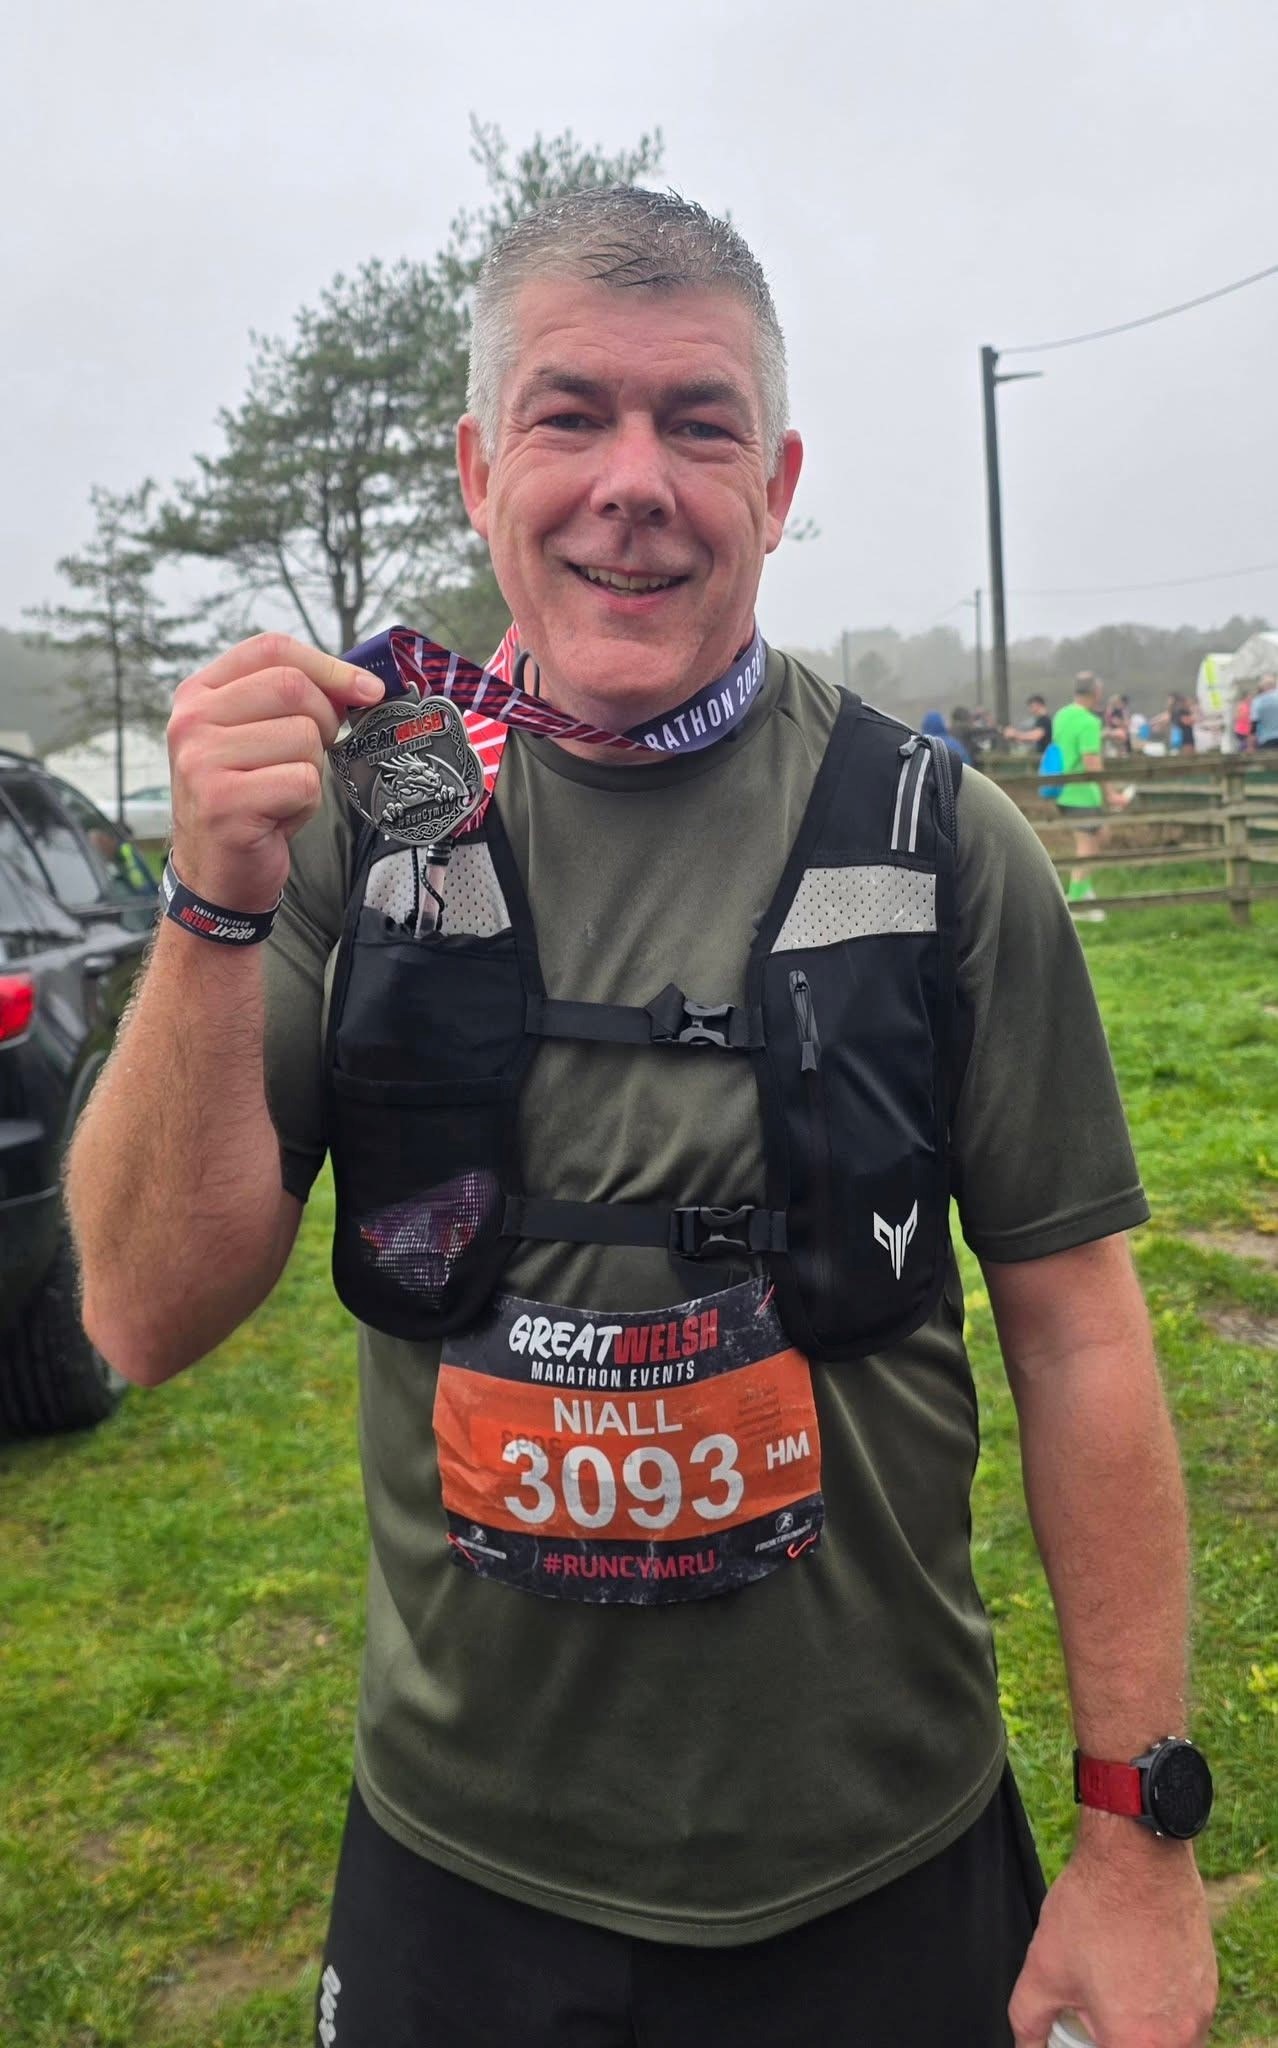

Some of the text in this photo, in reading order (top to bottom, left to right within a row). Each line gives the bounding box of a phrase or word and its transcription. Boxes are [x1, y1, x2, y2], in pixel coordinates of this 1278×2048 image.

[531, 1360, 695, 1388] MARATHON EVENTS
[553, 1397, 683, 1436] NIALL
[502, 1433, 745, 1529] 3093
[766, 1430, 811, 1470] HM
[543, 1549, 717, 1580] #RUNCYMRU
